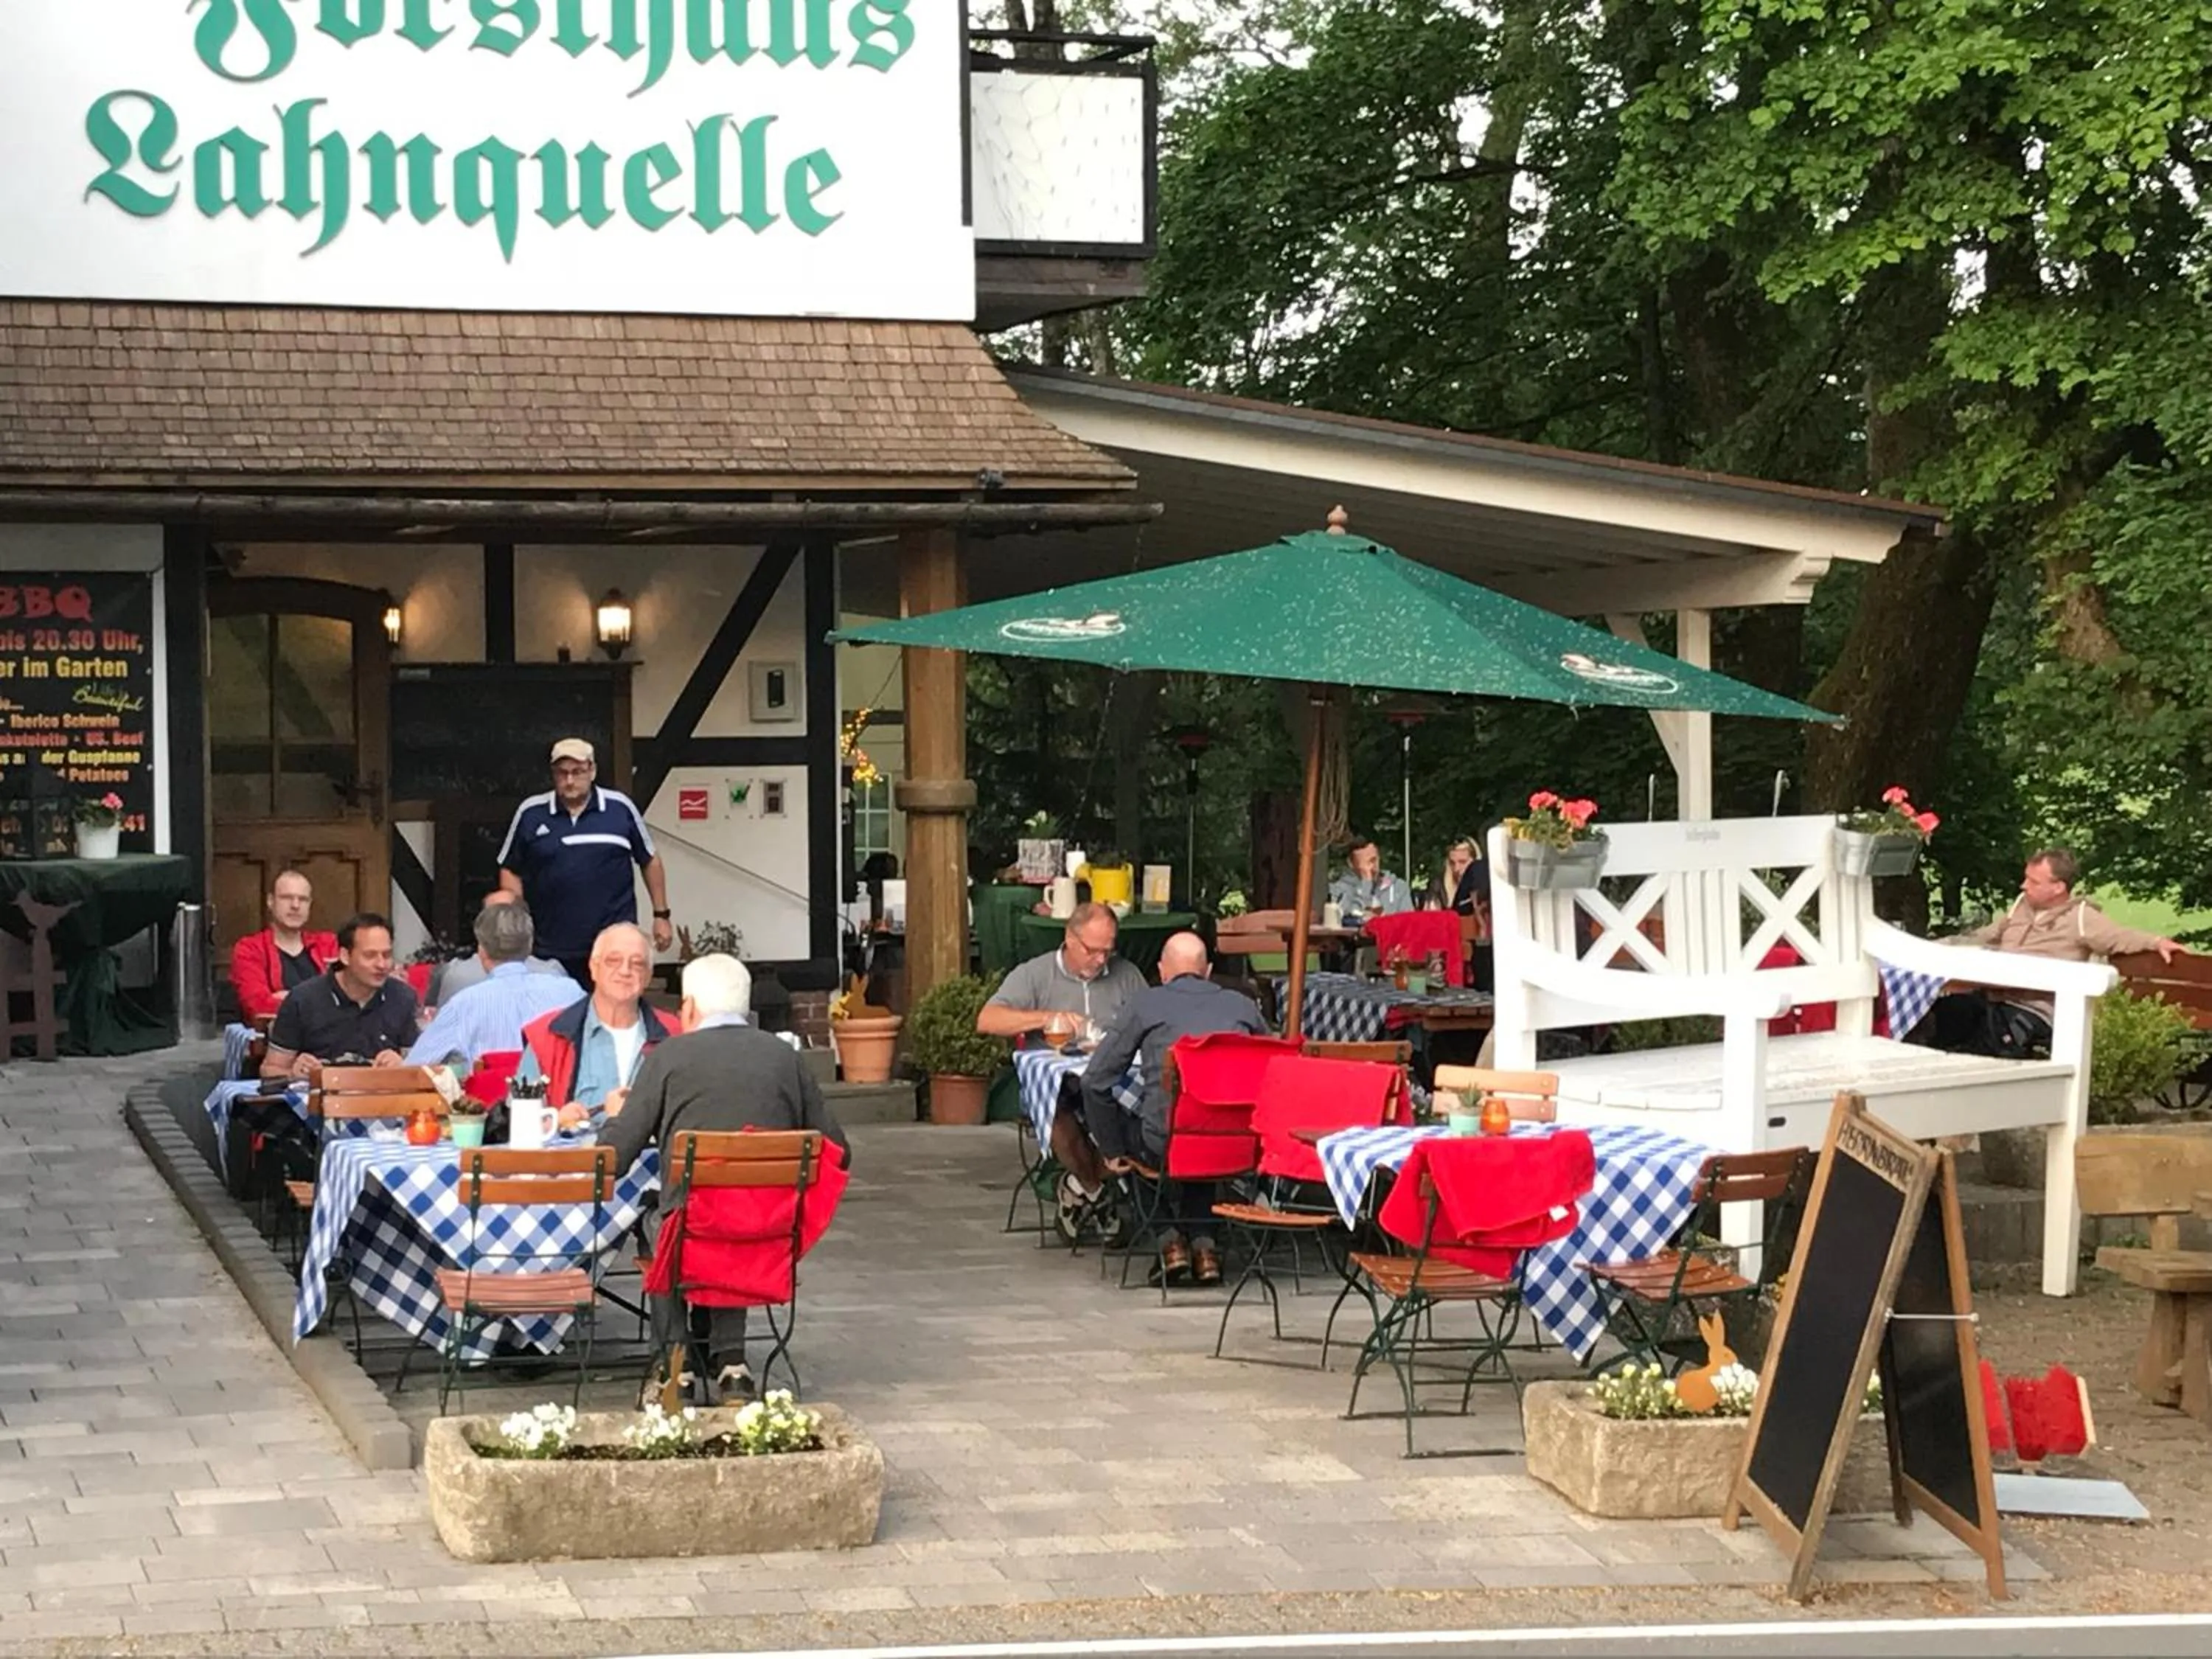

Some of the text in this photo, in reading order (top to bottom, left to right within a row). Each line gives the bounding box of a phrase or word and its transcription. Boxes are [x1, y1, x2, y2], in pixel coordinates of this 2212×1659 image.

[83, 89, 845, 264] Lahnquelle
[0, 585, 94, 622] BBQ
[33, 630, 95, 650] 20.30
[103, 630, 144, 654] Uhr,
[23, 656, 49, 678] im
[56, 656, 128, 678] Garten
